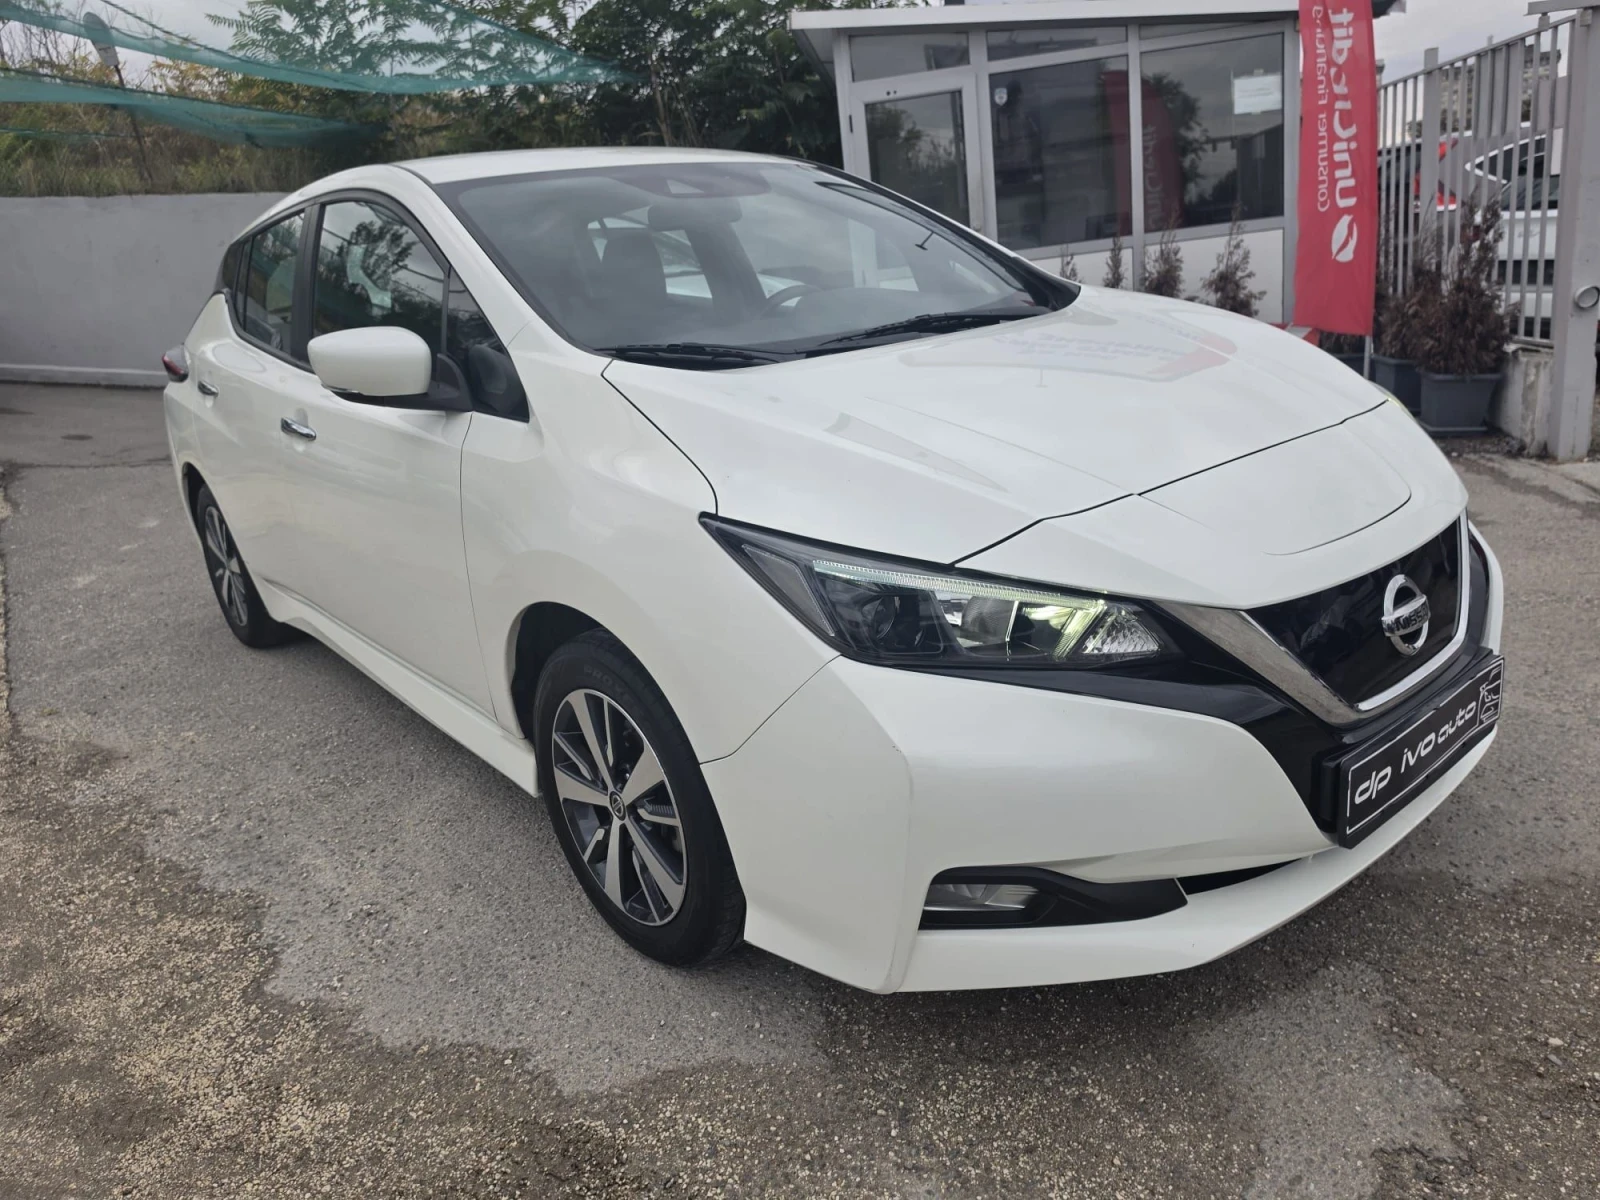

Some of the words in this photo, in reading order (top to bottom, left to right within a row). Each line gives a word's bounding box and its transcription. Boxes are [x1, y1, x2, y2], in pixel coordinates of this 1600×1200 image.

[1354, 765, 1392, 805] dp
[1400, 731, 1436, 774] ivo
[1437, 701, 1477, 744] auto
